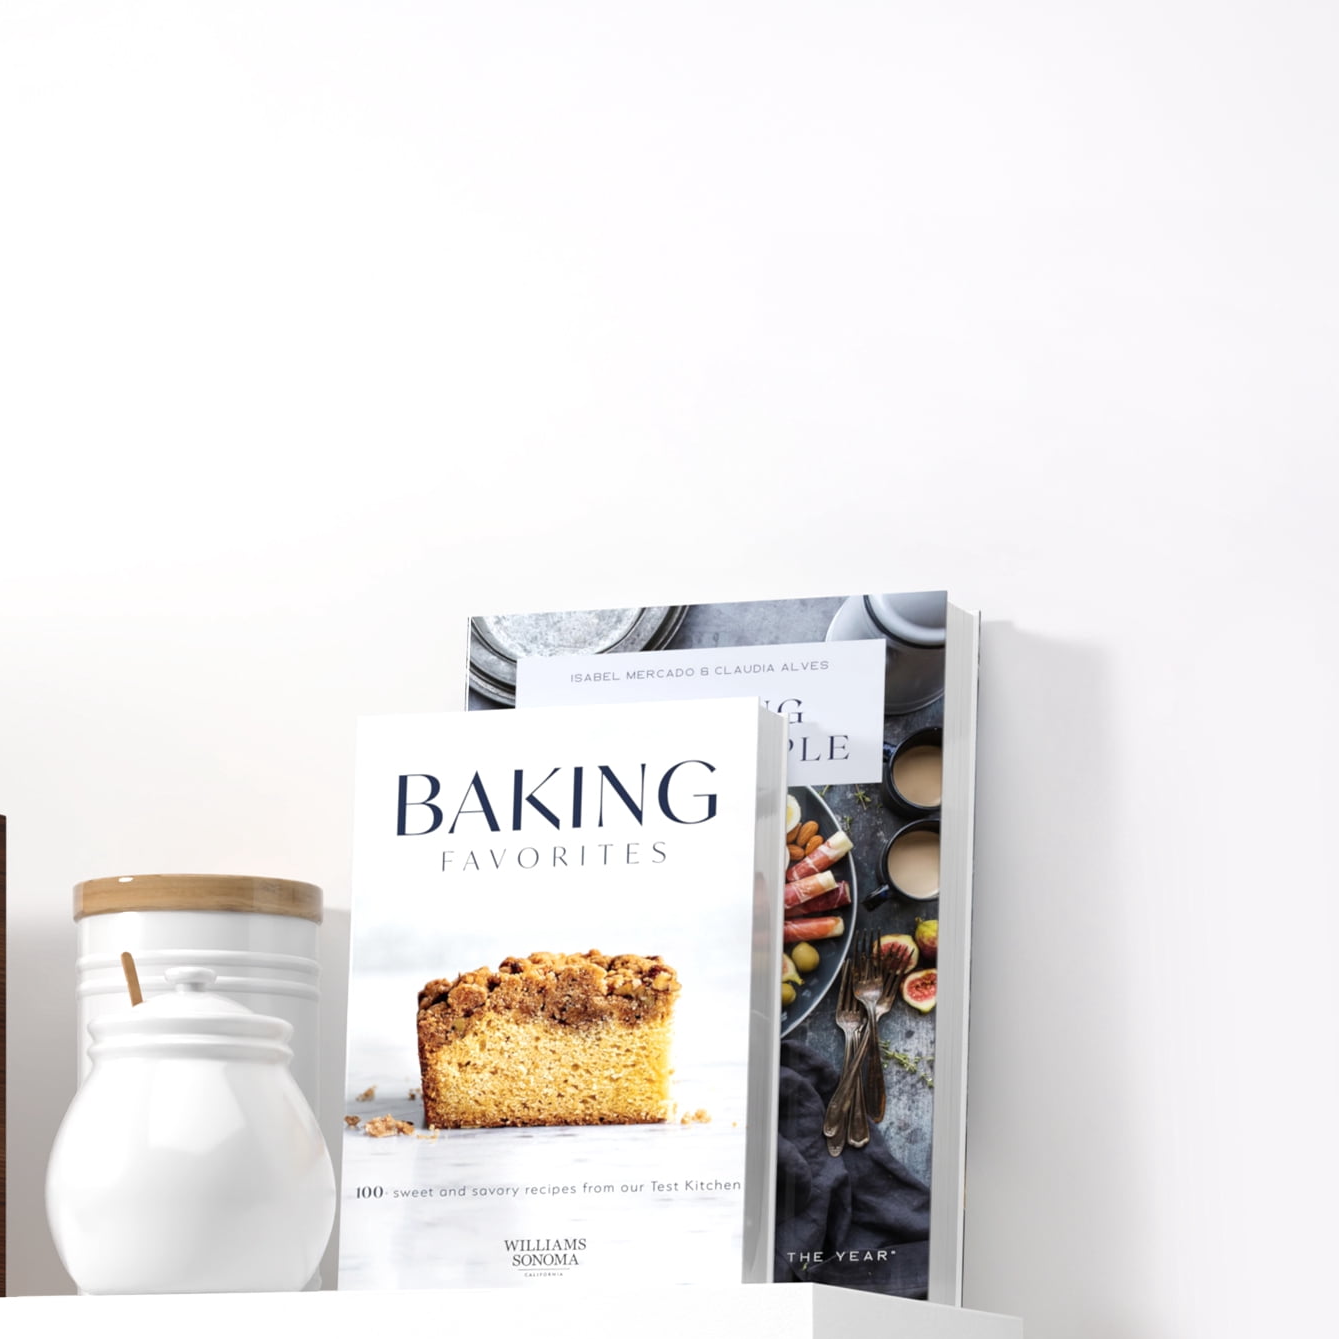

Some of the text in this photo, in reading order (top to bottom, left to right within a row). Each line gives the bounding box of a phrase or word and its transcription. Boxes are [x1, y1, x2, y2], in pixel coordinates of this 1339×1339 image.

[570, 671, 621, 683] ISABEL
[626, 667, 695, 680] MERCADO
[714, 663, 775, 676] CLAUDIA
[781, 660, 830, 672] ALVES
[396, 759, 718, 837] BAKING
[441, 841, 668, 872] FAVORITES
[393, 1188, 434, 1199] sweet
[439, 1185, 467, 1198] and
[472, 1187, 520, 1200] savory
[525, 1184, 577, 1198] recipes
[582, 1182, 615, 1194] from
[620, 1184, 645, 1193] our
[651, 1180, 679, 1192] Test
[685, 1178, 741, 1192] Kitchen
[504, 1238, 587, 1252] WILLIAMS
[512, 1253, 579, 1267] SONOMA
[787, 1251, 823, 1263] THE
